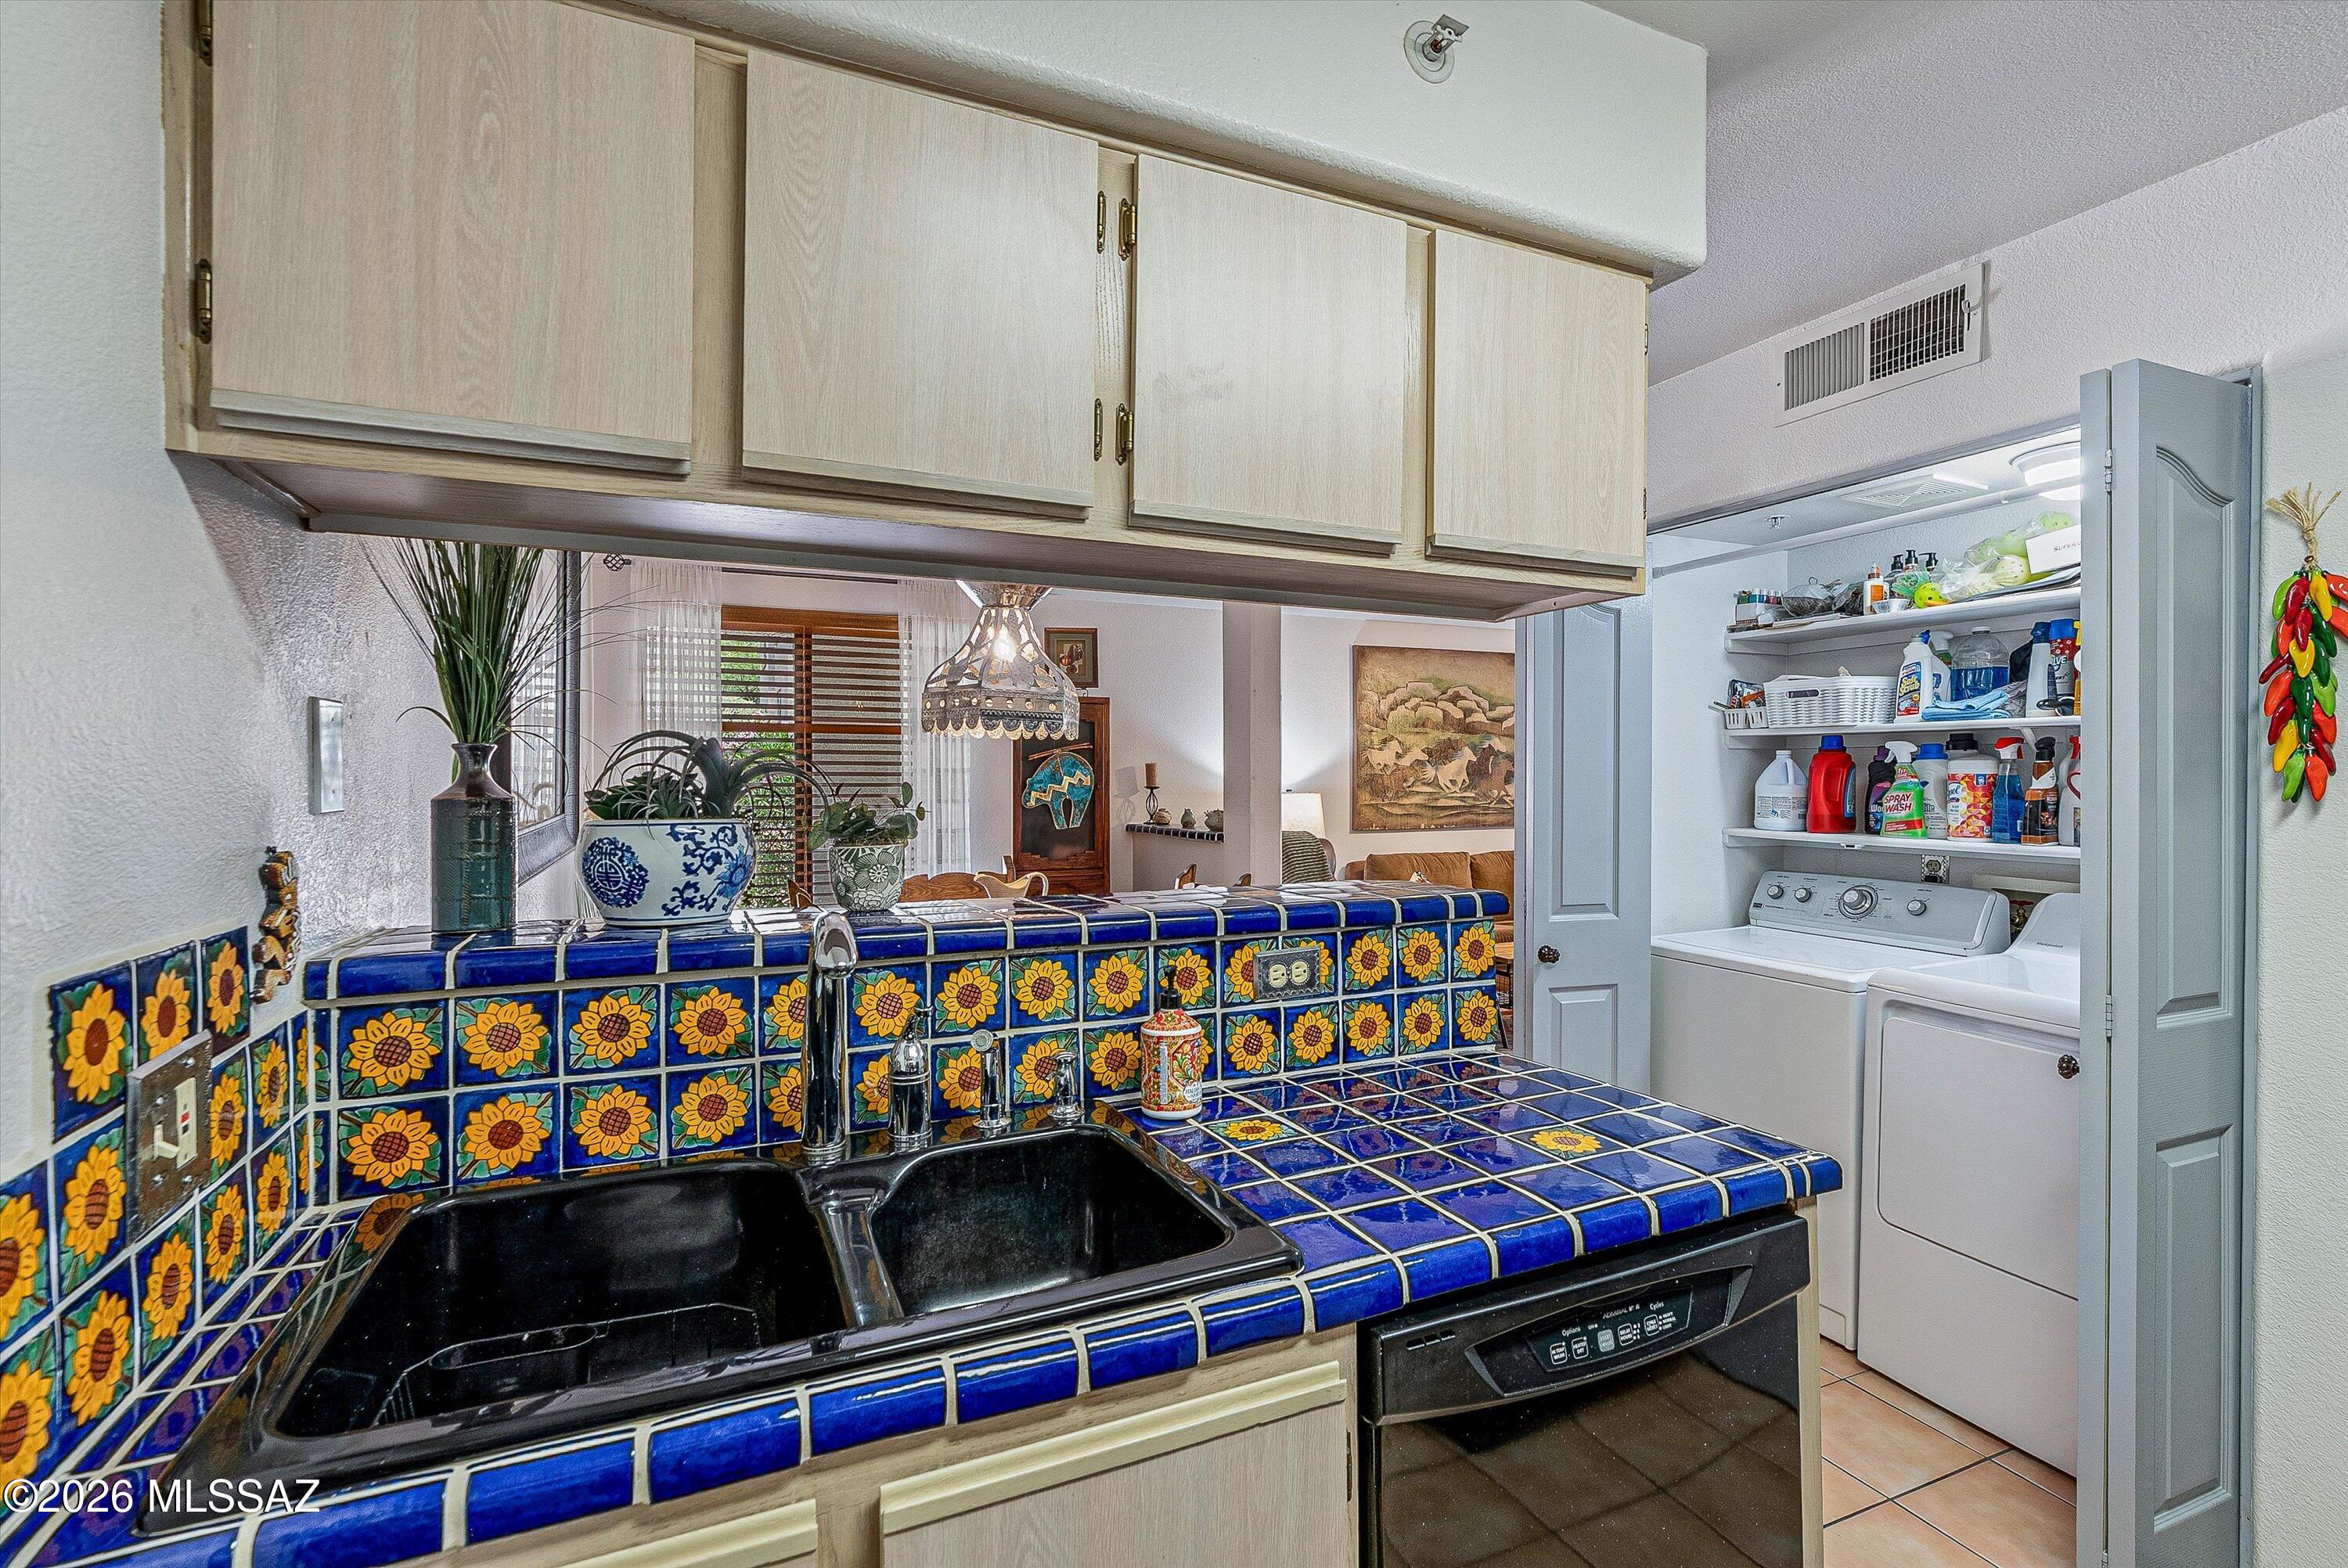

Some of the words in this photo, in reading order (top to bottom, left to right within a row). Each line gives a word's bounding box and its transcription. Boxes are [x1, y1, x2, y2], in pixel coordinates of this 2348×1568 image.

[1900, 674, 1918, 687] Soft
[1899, 682, 1920, 696] Scrub
[1884, 792, 1912, 804] SPRAY
[1885, 802, 1913, 813] WASH
[1923, 802, 1936, 812] lite
[1650, 1302, 1664, 1311] Cycles
[1603, 1307, 1628, 1319] ADMIRAL
[1562, 1327, 1581, 1336] Options
